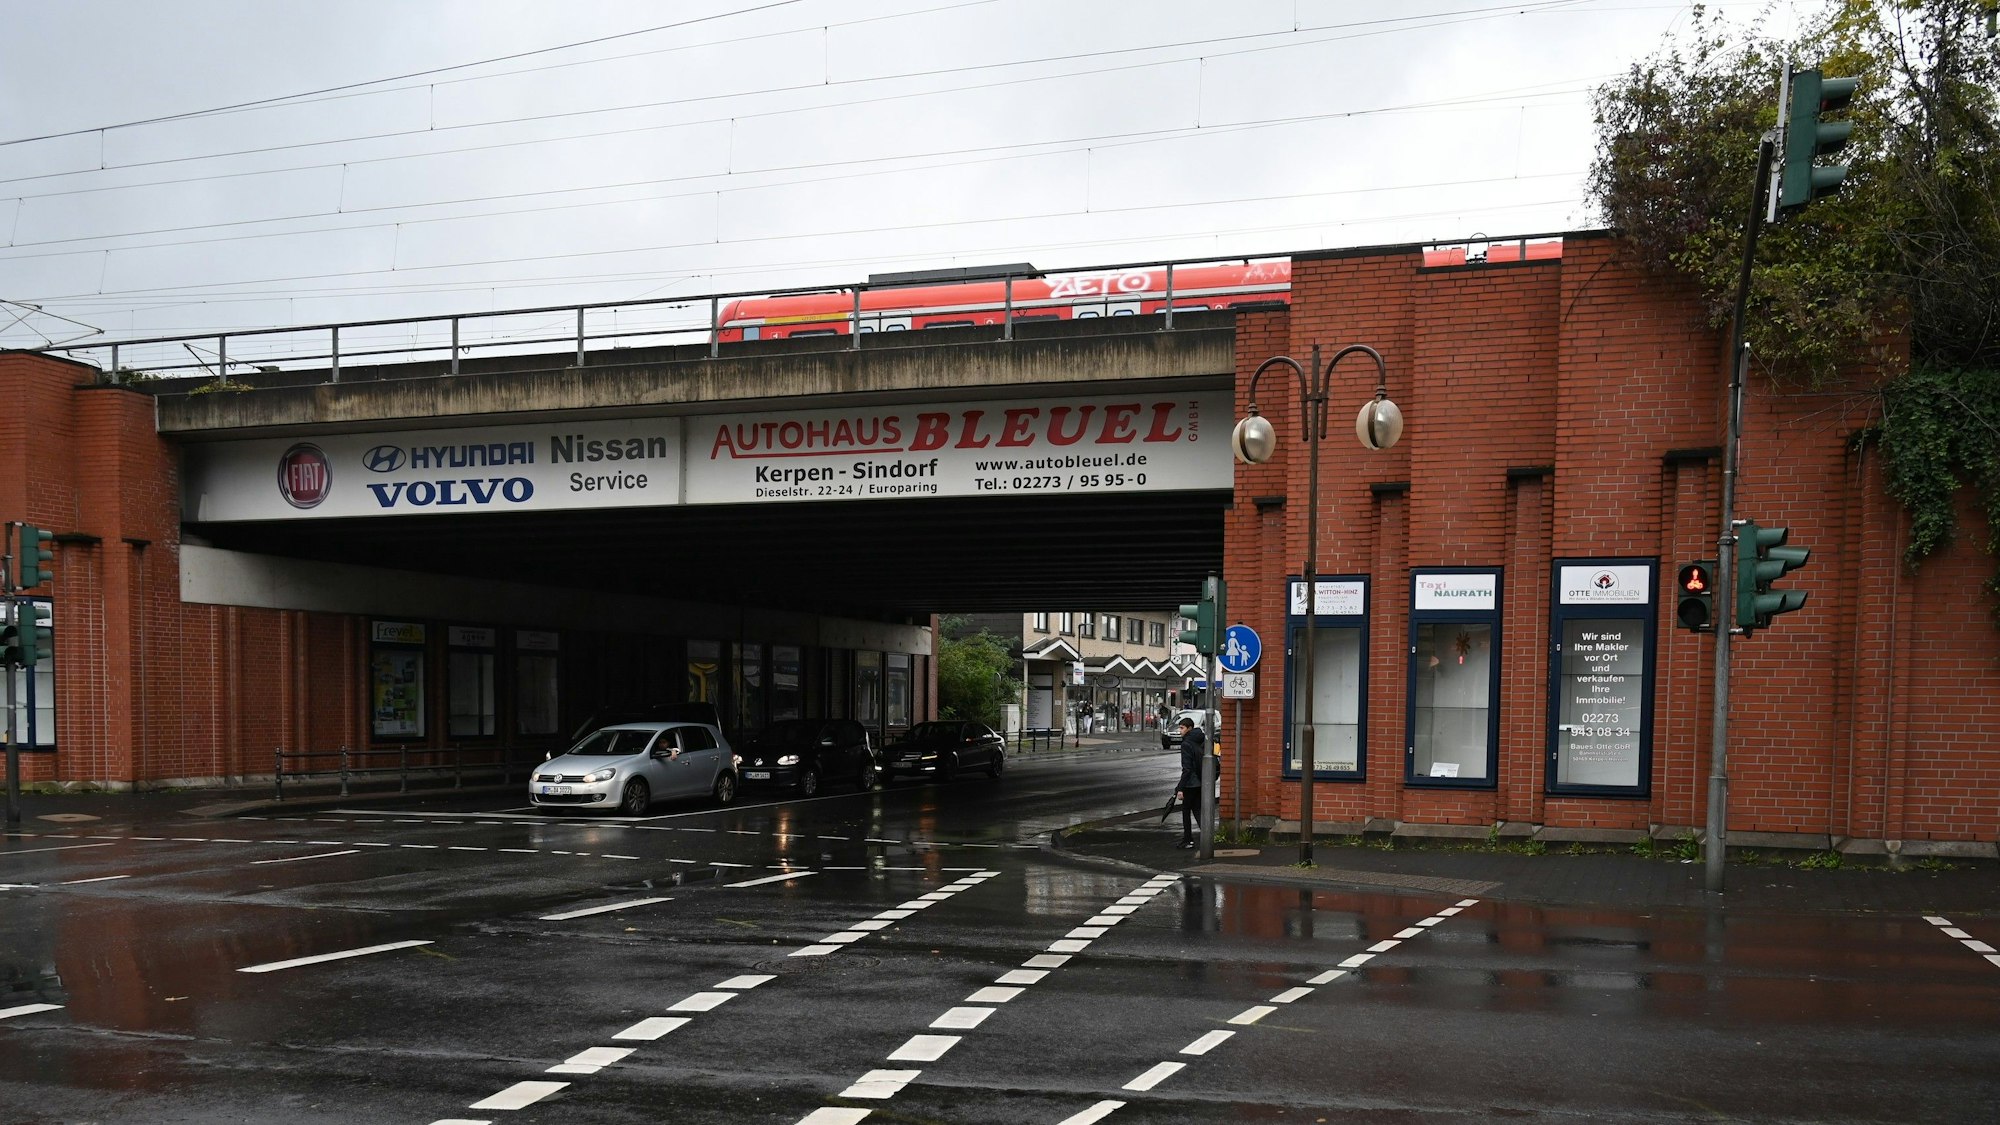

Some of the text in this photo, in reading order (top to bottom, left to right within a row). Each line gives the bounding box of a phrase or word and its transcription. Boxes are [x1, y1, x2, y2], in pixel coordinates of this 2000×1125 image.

[1188, 400, 1199, 442] GMBH
[711, 402, 1182, 460] AUTOHAUS BLEUEL
[411, 441, 535, 469] HYUNDAI
[551, 434, 667, 464] Nissan
[975, 453, 1148, 471] www.autobleuel.de
[291, 462, 321, 492] FIAT
[755, 465, 834, 486] Kerpen
[852, 458, 939, 480] Sindorf
[569, 470, 648, 492] Service
[975, 477, 1008, 491] Tel.:
[1012, 475, 1062, 490] 02273
[1079, 474, 1100, 488] 95
[366, 477, 534, 508] VOLVO
[756, 487, 814, 498] Dieselstr.
[818, 484, 853, 496] 22-24
[868, 481, 938, 495] Europaring
[1419, 581, 1447, 590] Taxi
[1568, 589, 1640, 598] OTTE IMMOBILIEN
[1582, 632, 1622, 641] Wir sind
[1574, 643, 1629, 652] Ihre Makler
[1602, 653, 1618, 662] Ort
[1591, 664, 1611, 672] und
[1577, 674, 1625, 683] verkaufen
[1591, 685, 1611, 693] Ihre
[1576, 696, 1627, 704] Immobilie!
[1581, 713, 1619, 723] 02273
[1570, 726, 1631, 737] 943 08 34
